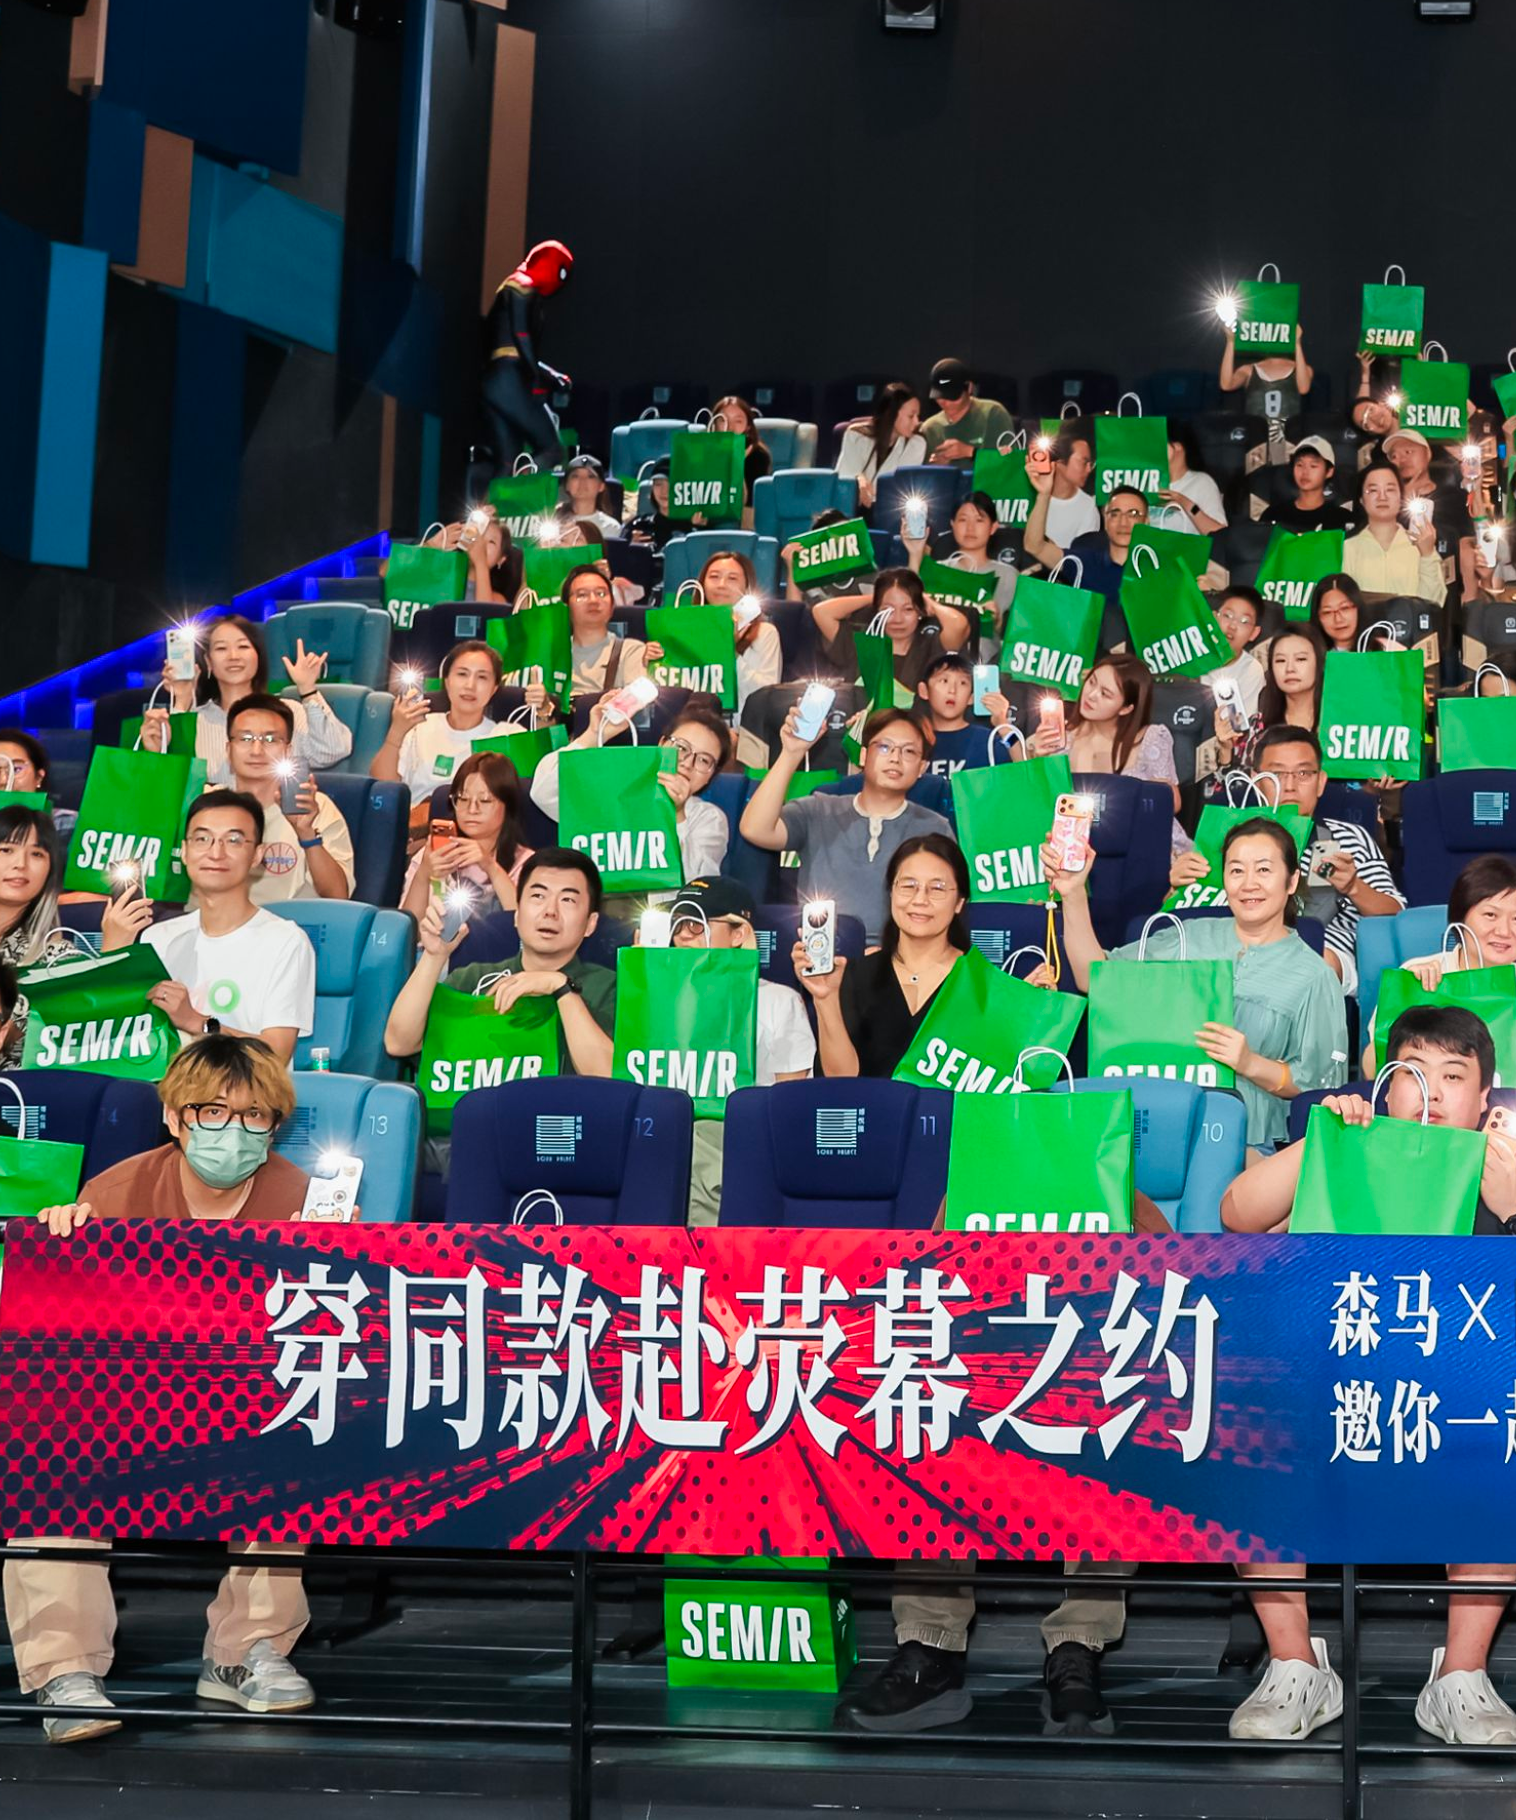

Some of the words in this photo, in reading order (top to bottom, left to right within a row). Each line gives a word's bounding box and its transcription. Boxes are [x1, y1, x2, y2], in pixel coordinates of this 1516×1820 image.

[370, 932, 388, 946] 14
[370, 1115, 388, 1136] 13
[635, 1118, 655, 1138] 12
[920, 1116, 937, 1136] 11
[1202, 1124, 1224, 1143] 10
[261, 1263, 1218, 1462] 穿同款赴荧幕之约
